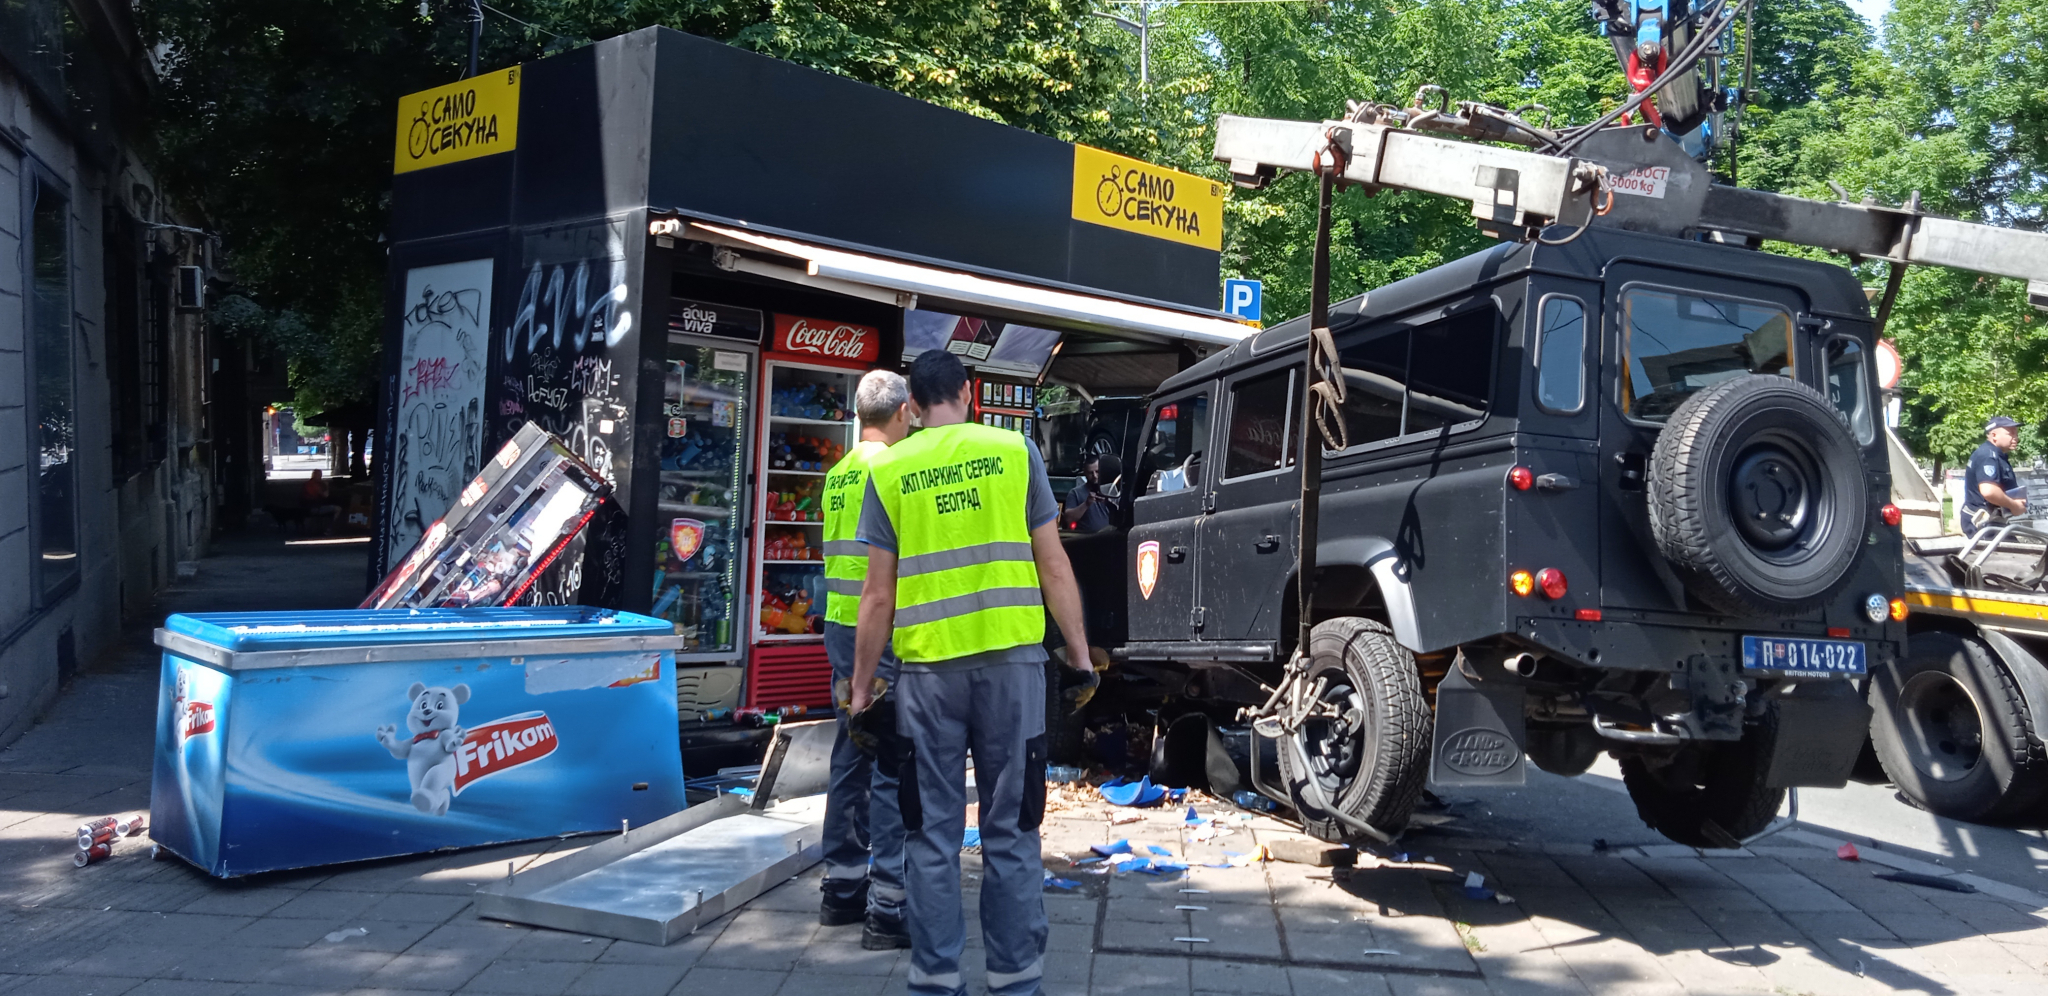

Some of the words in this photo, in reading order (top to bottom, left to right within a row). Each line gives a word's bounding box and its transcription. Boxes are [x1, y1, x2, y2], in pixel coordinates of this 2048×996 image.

[432, 89, 475, 124] САМО
[429, 114, 498, 155] СЕКУНД
[1125, 169, 1174, 202] САМО
[1611, 176, 1638, 190] 5000
[1640, 180, 1654, 195] kg
[1123, 197, 1200, 236] СЕКУНД
[683, 304, 717, 322] aqua
[1232, 284, 1253, 315] P
[685, 319, 713, 333] viva
[901, 472, 920, 495] ЈКП
[919, 463, 963, 489] ПАРКИНГ
[965, 456, 1004, 480] СЕРВИС
[935, 487, 982, 515] БЕОГРАД
[1784, 669, 1807, 678] BRITISH
[1807, 670, 1830, 679] MOTORS
[455, 722, 556, 778] Frikom
[1455, 734, 1499, 751] LAND
[1458, 750, 1509, 767] ROVER
